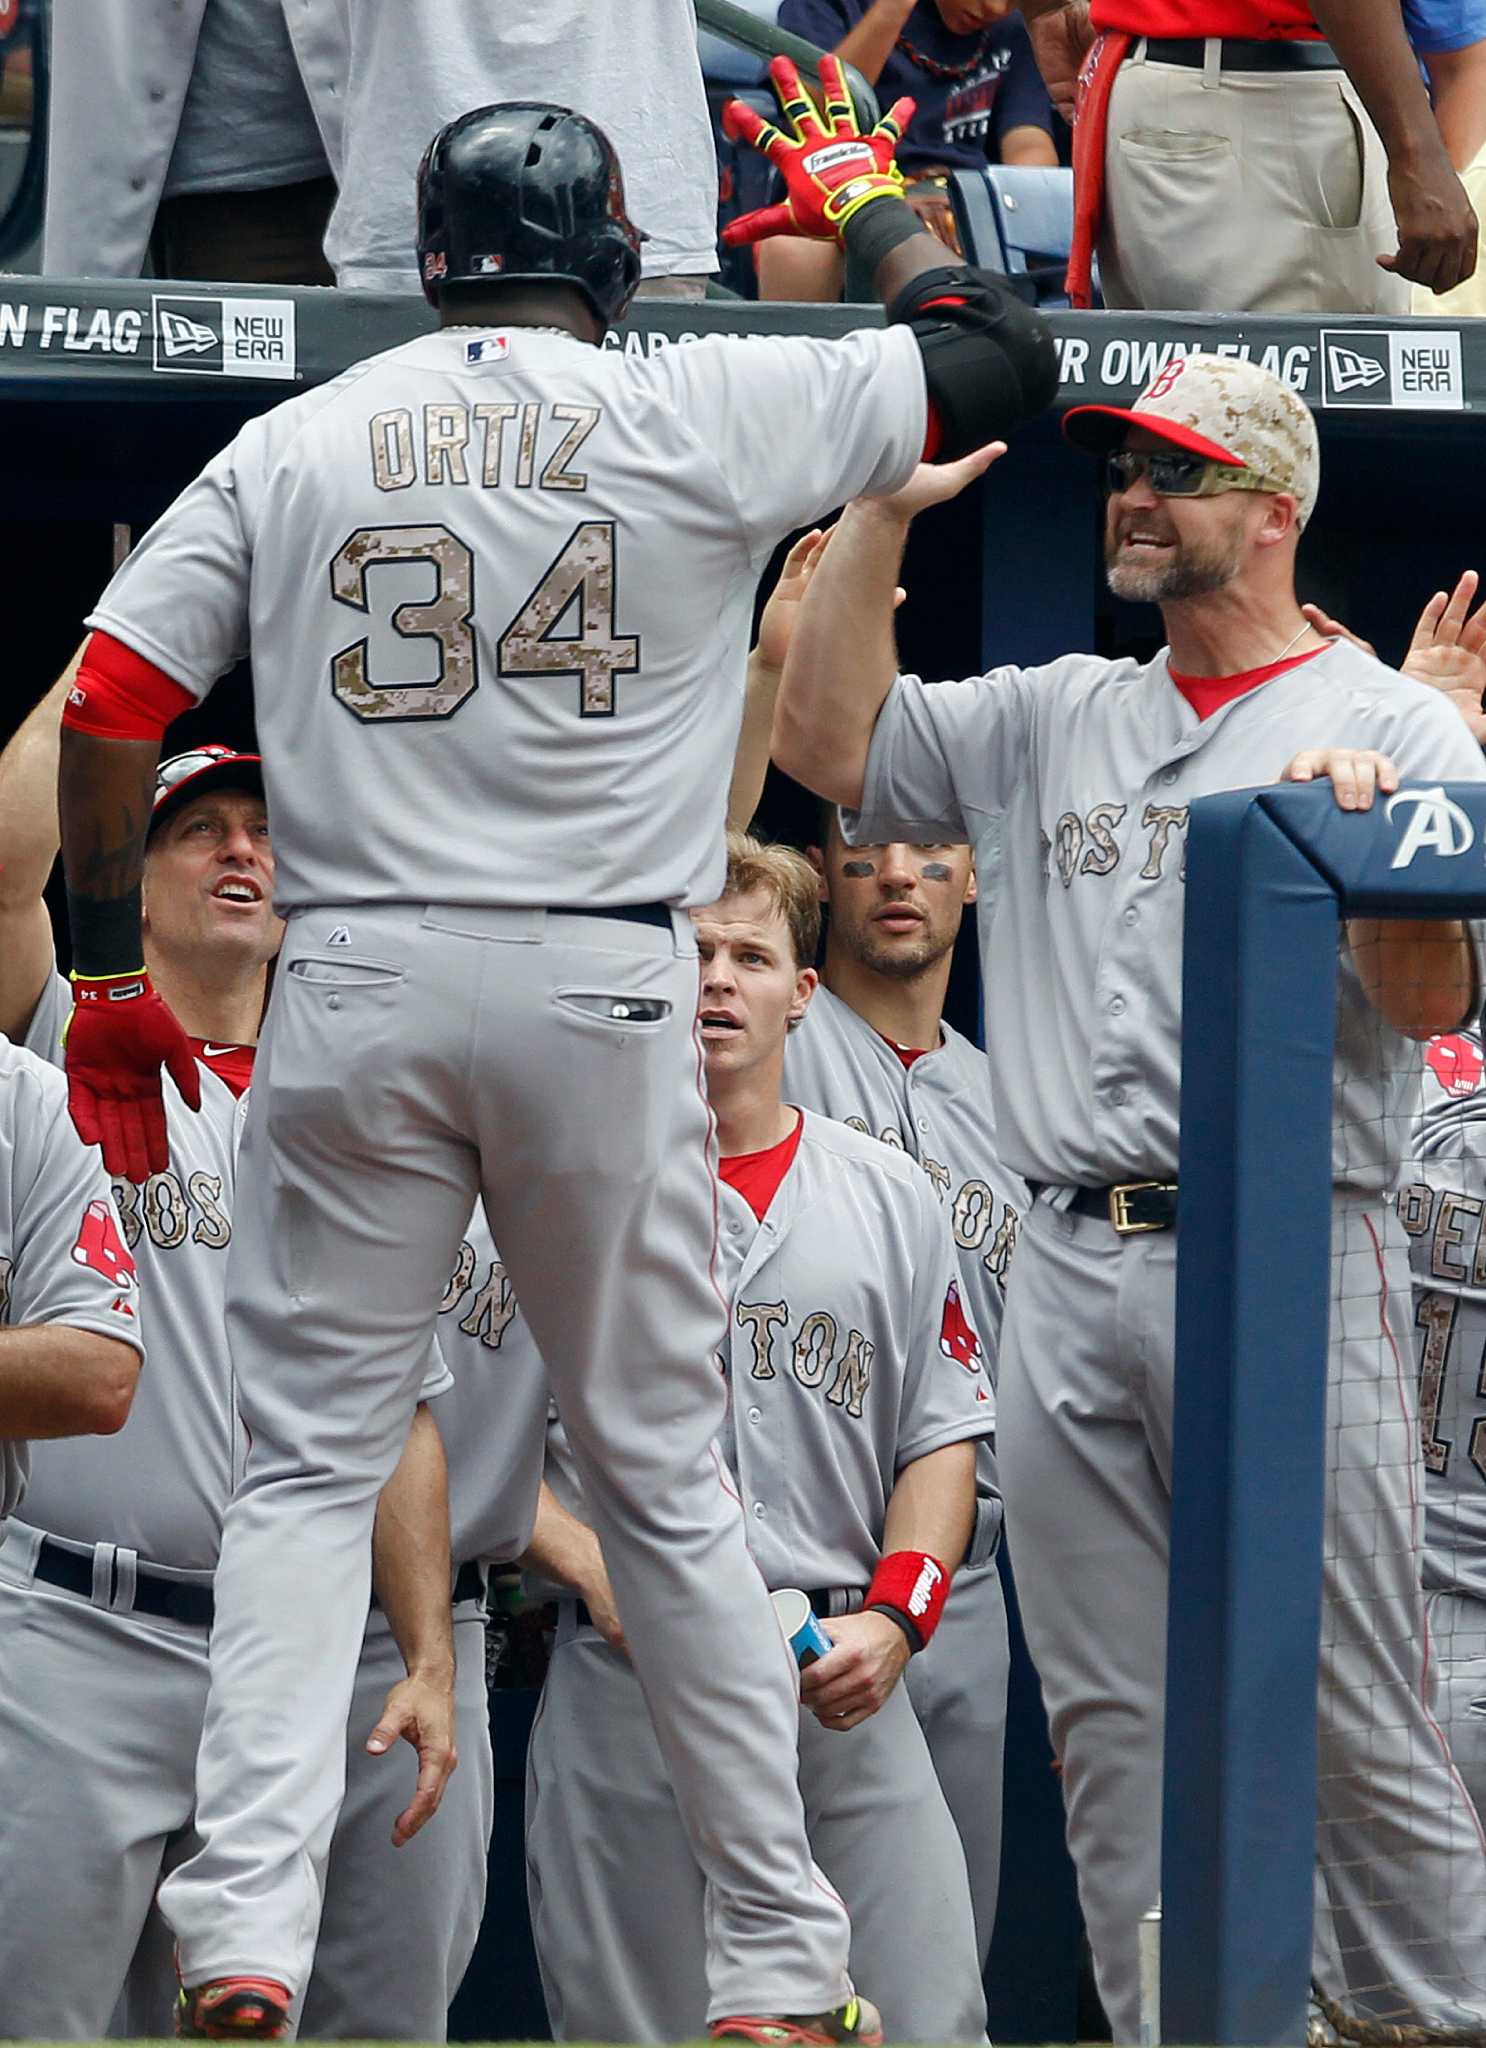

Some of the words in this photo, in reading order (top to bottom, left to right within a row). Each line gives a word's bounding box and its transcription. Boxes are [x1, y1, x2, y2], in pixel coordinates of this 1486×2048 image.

[40, 306, 142, 353] FLAG
[234, 316, 284, 338] NEW
[234, 339, 284, 361] ERA
[1053, 338, 1090, 383] R
[1217, 344, 1312, 391] AG
[1142, 359, 1185, 400] B
[1401, 348, 1450, 370] NEW
[1401, 370, 1452, 392] ERA
[369, 403, 602, 492] ORTIZ
[329, 520, 641, 725] 34
[736, 1299, 876, 1420] TON
[1414, 1291, 1486, 1486] 1
